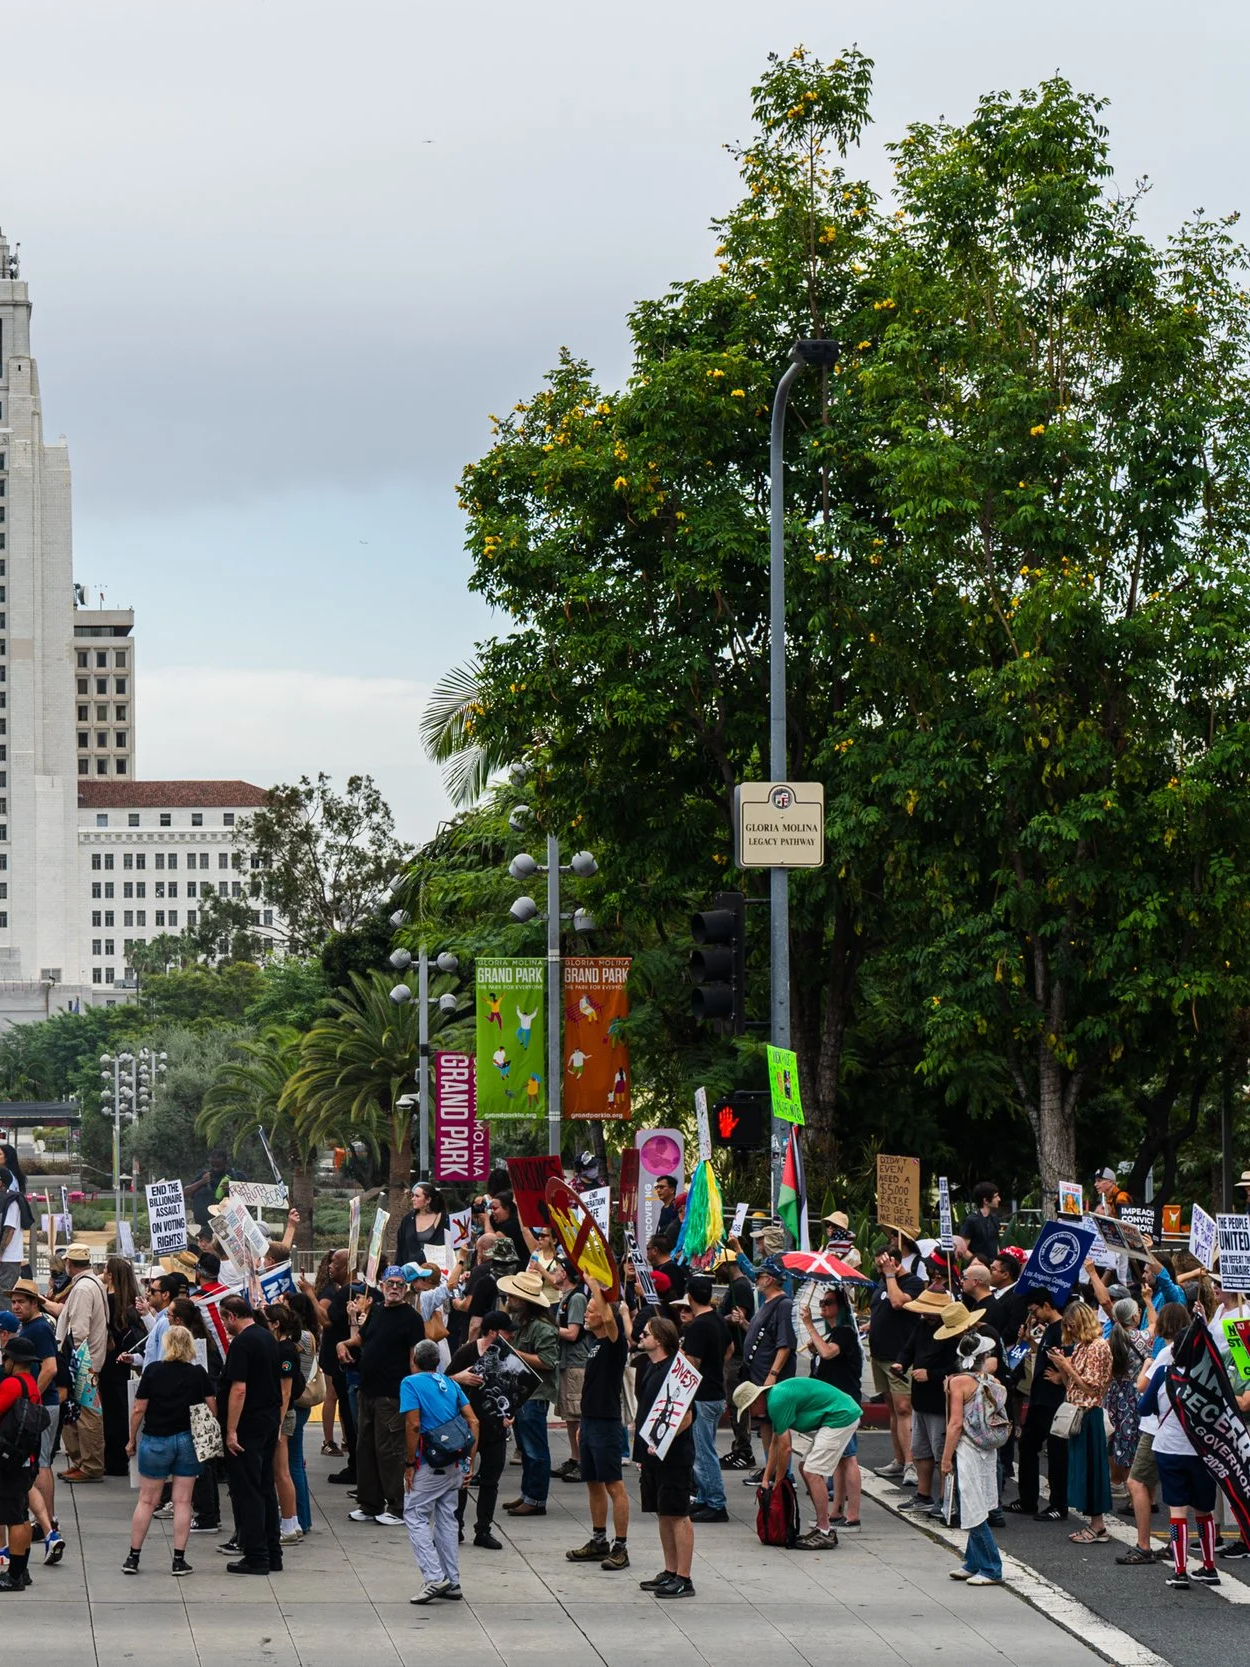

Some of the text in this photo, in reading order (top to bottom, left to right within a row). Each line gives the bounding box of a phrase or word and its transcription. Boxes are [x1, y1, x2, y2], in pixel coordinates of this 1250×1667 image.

[746, 824, 818, 832] GLORIA MOLINA
[749, 838, 815, 846] LEGACY PATHWAY
[477, 967, 543, 983] GRAND PARK
[564, 967, 629, 983] GRAND PARK
[440, 1054, 469, 1177] GRAND PARK
[484, 1112, 537, 1120] grandparkla.org
[571, 1112, 623, 1120] grandparkla.org
[473, 1120, 484, 1177] MOLINA
[880, 1156, 907, 1165] DIDN'T
[510, 1162, 526, 1192] NO
[880, 1166, 903, 1174] EVEN
[878, 1175, 910, 1184] NEED A
[152, 1182, 179, 1196] END THE
[243, 1185, 267, 1204] TRUTH
[589, 1191, 598, 1199] END
[149, 1193, 182, 1208] BILLIONAIRE
[880, 1196, 909, 1206] BRIBE
[156, 1204, 180, 1218] ASSAULT
[879, 1205, 912, 1215] TO GET
[1121, 1207, 1154, 1217] IMPEACH
[152, 1217, 185, 1234] ON VOTING
[893, 1215, 915, 1226] HERE
[1121, 1215, 1154, 1225] CONVICT
[1218, 1216, 1248, 1229] THE PEOPLE
[157, 1232, 183, 1248] RIGHTS!
[1219, 1231, 1250, 1250] UNITED
[1230, 1255, 1243, 1264] DEFEAT
[1033, 1271, 1052, 1283] Angeles
[1051, 1277, 1071, 1289] College
[672, 1357, 699, 1394] DIVEST
[1195, 1426, 1250, 1499] GOVERNOR
[1203, 1454, 1229, 1479] 2026
